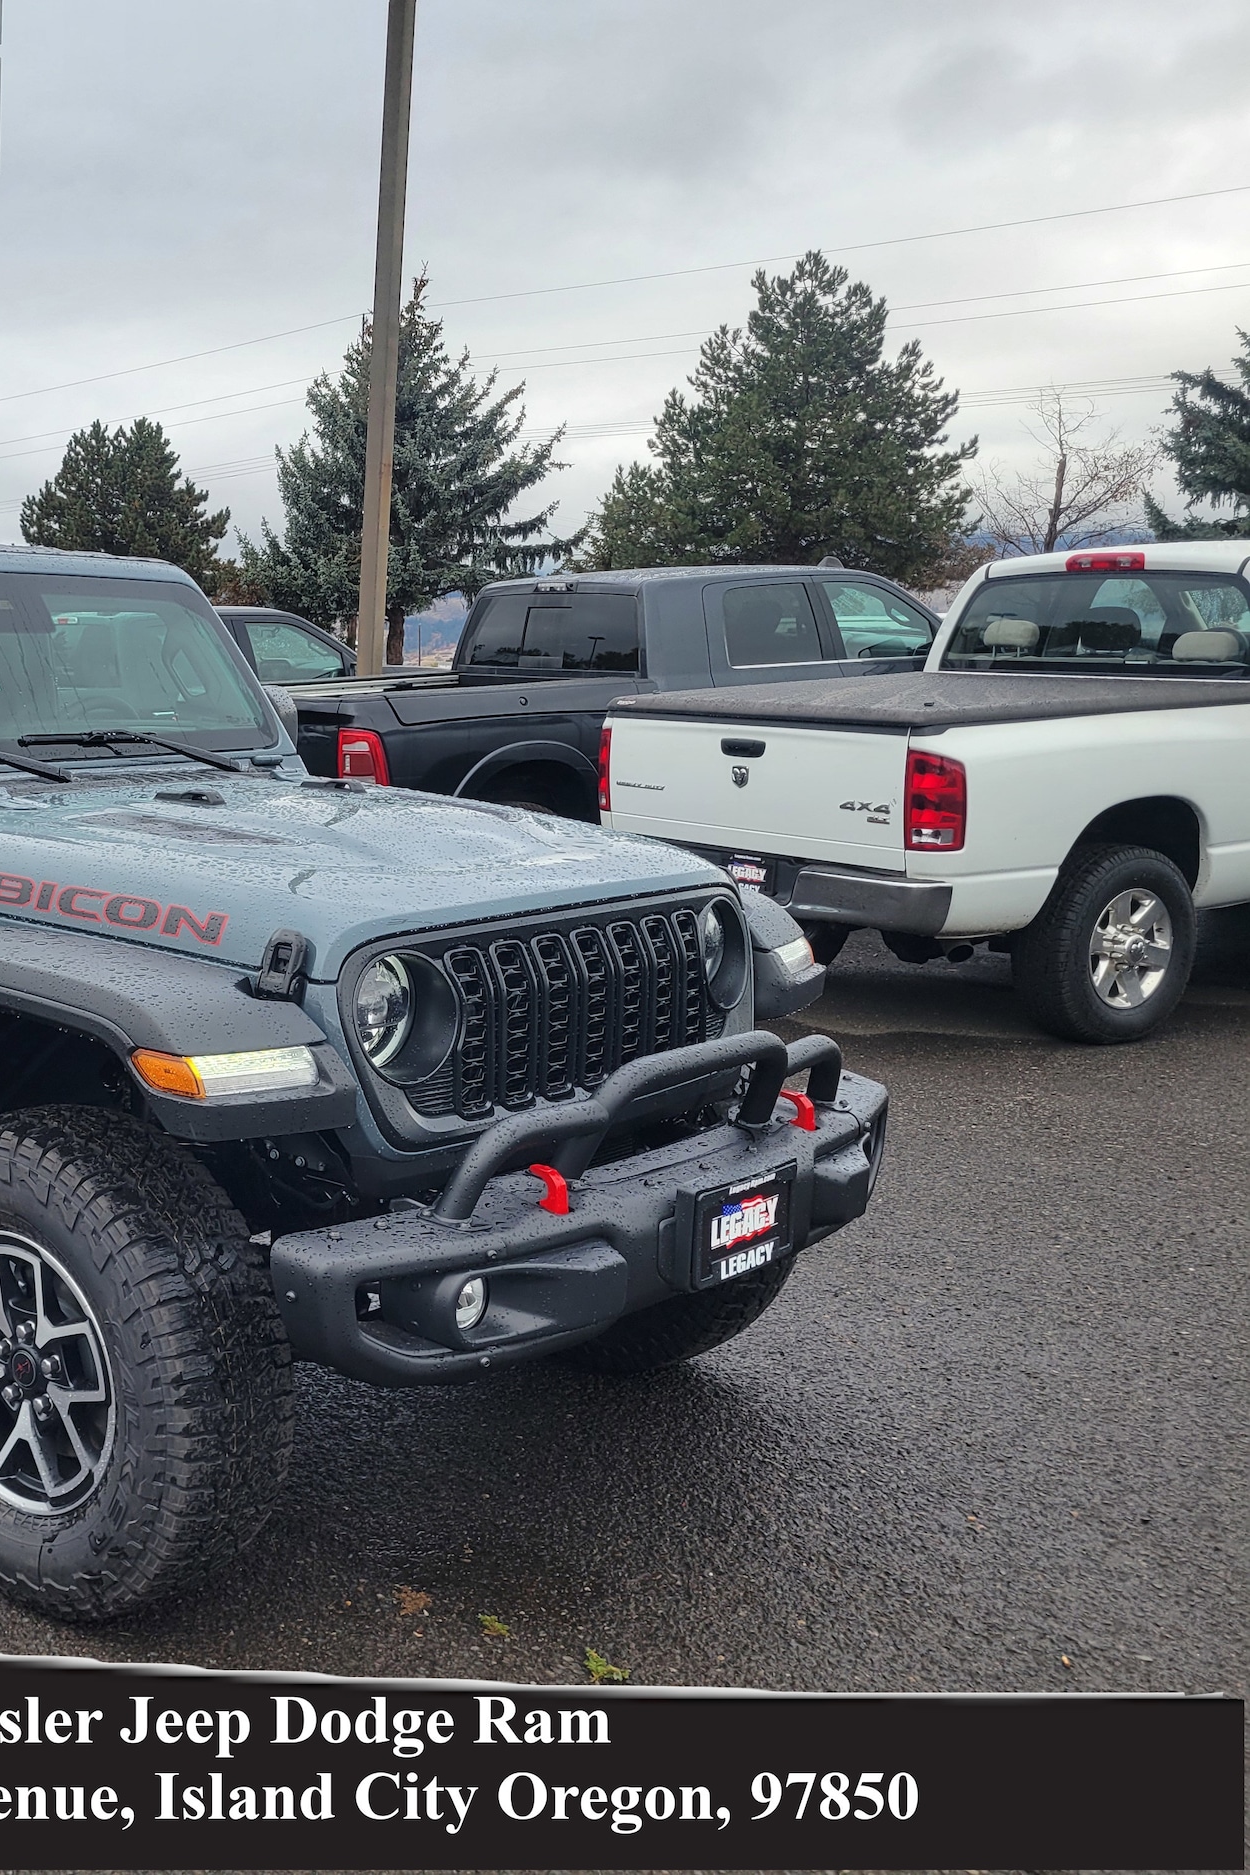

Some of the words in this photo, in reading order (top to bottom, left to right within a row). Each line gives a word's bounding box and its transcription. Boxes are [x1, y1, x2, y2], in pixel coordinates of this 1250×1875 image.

[839, 800, 891, 815] 4X4
[711, 1196, 779, 1248] LEGACY
[720, 1241, 775, 1281] LEGACY
